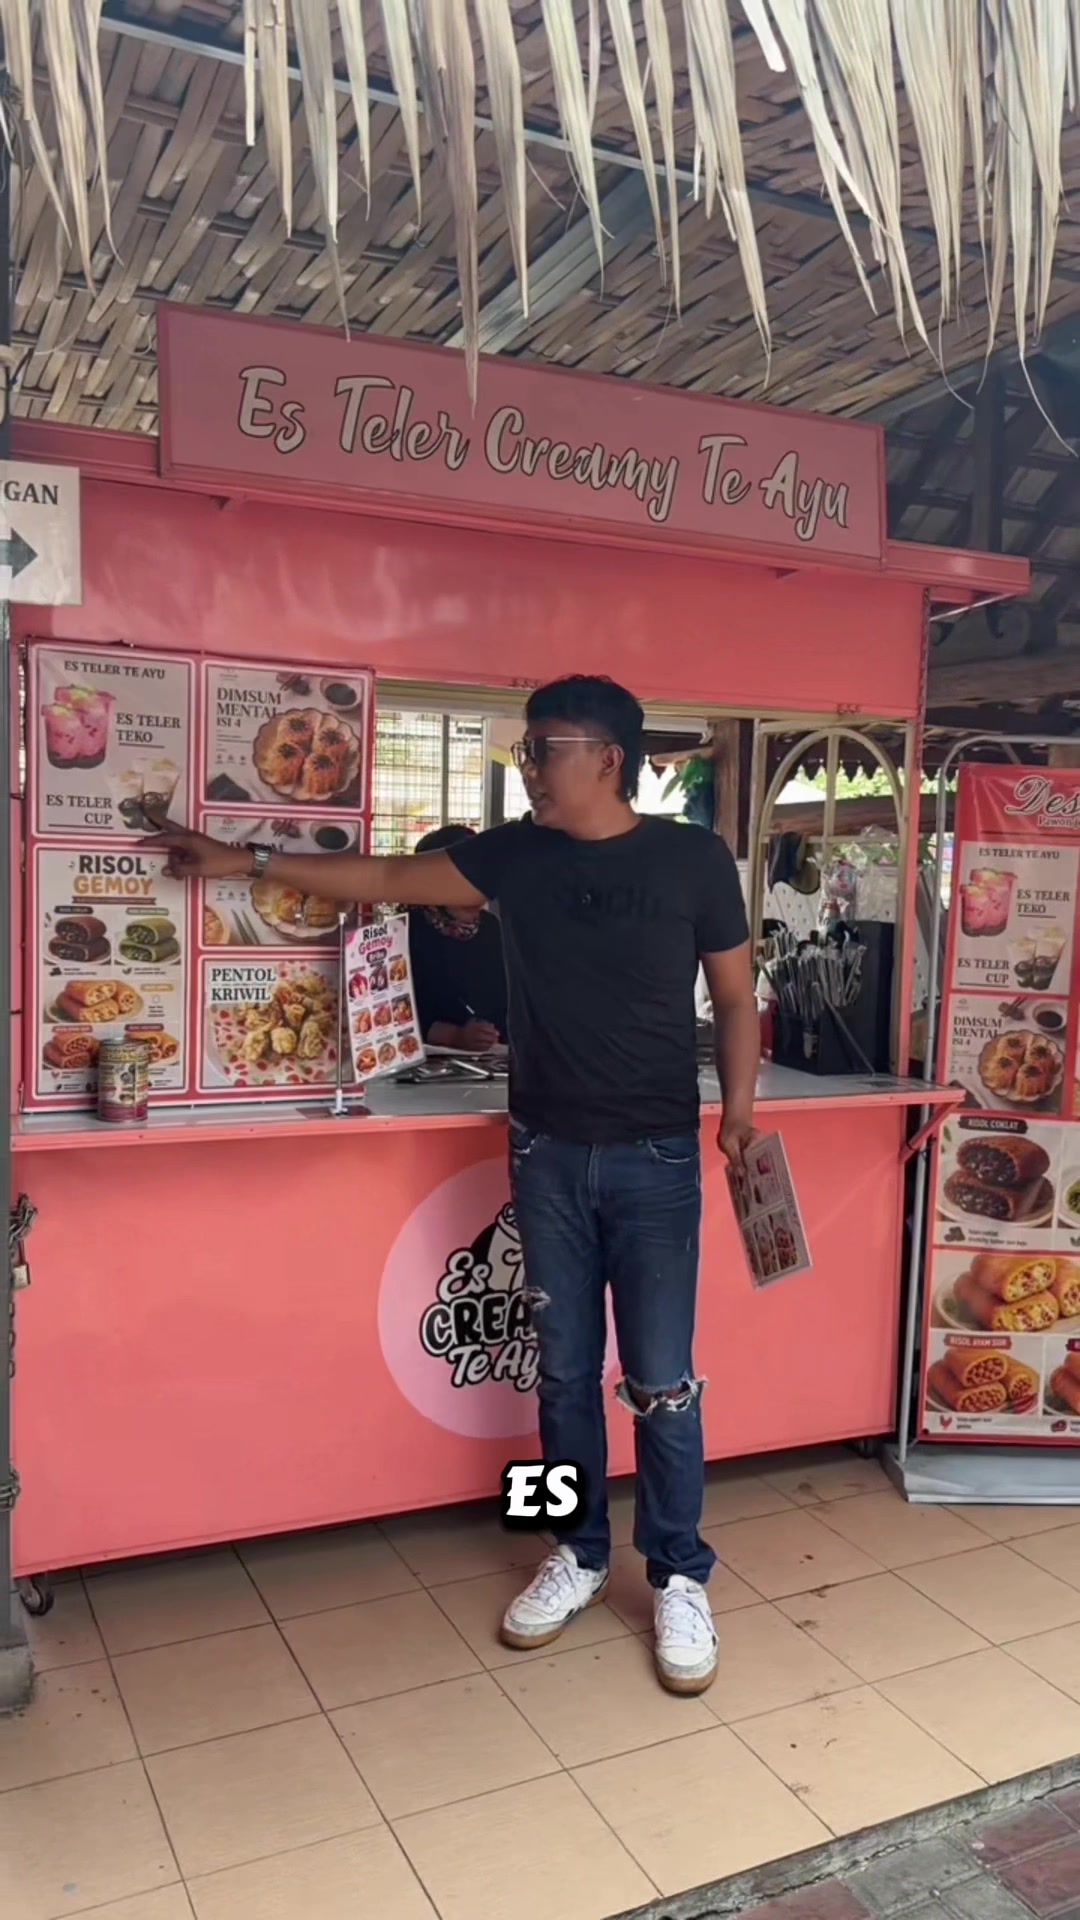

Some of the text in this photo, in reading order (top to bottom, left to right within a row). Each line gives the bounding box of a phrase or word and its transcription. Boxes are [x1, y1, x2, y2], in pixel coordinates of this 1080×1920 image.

[238, 365, 849, 541] Es Teler Creamy Te Ayu
[0, 479, 59, 506] GAN
[64, 660, 166, 680] ES TELER TE AYU
[217, 687, 281, 705] DIMSUM
[116, 713, 181, 729] ES TELER
[116, 729, 153, 743] TEKO
[46, 794, 113, 809] ES TELER
[84, 813, 113, 825] CUP
[979, 847, 1060, 860] ES TELER TE AYU
[79, 854, 147, 876] RISOL
[73, 875, 153, 896] GEMOY
[1016, 889, 1070, 902] ES TELER
[1017, 902, 1047, 914] TEKO
[363, 923, 388, 941] Risol
[359, 936, 393, 955] Gemoy
[957, 958, 1009, 970] ES TELER
[211, 968, 276, 983] PENTOL
[985, 973, 1009, 984] CUP
[211, 987, 271, 1001] KRIWIL
[953, 1015, 1002, 1028] DIMSUM
[436, 1248, 493, 1302] Es
[447, 1344, 491, 1387] Te
